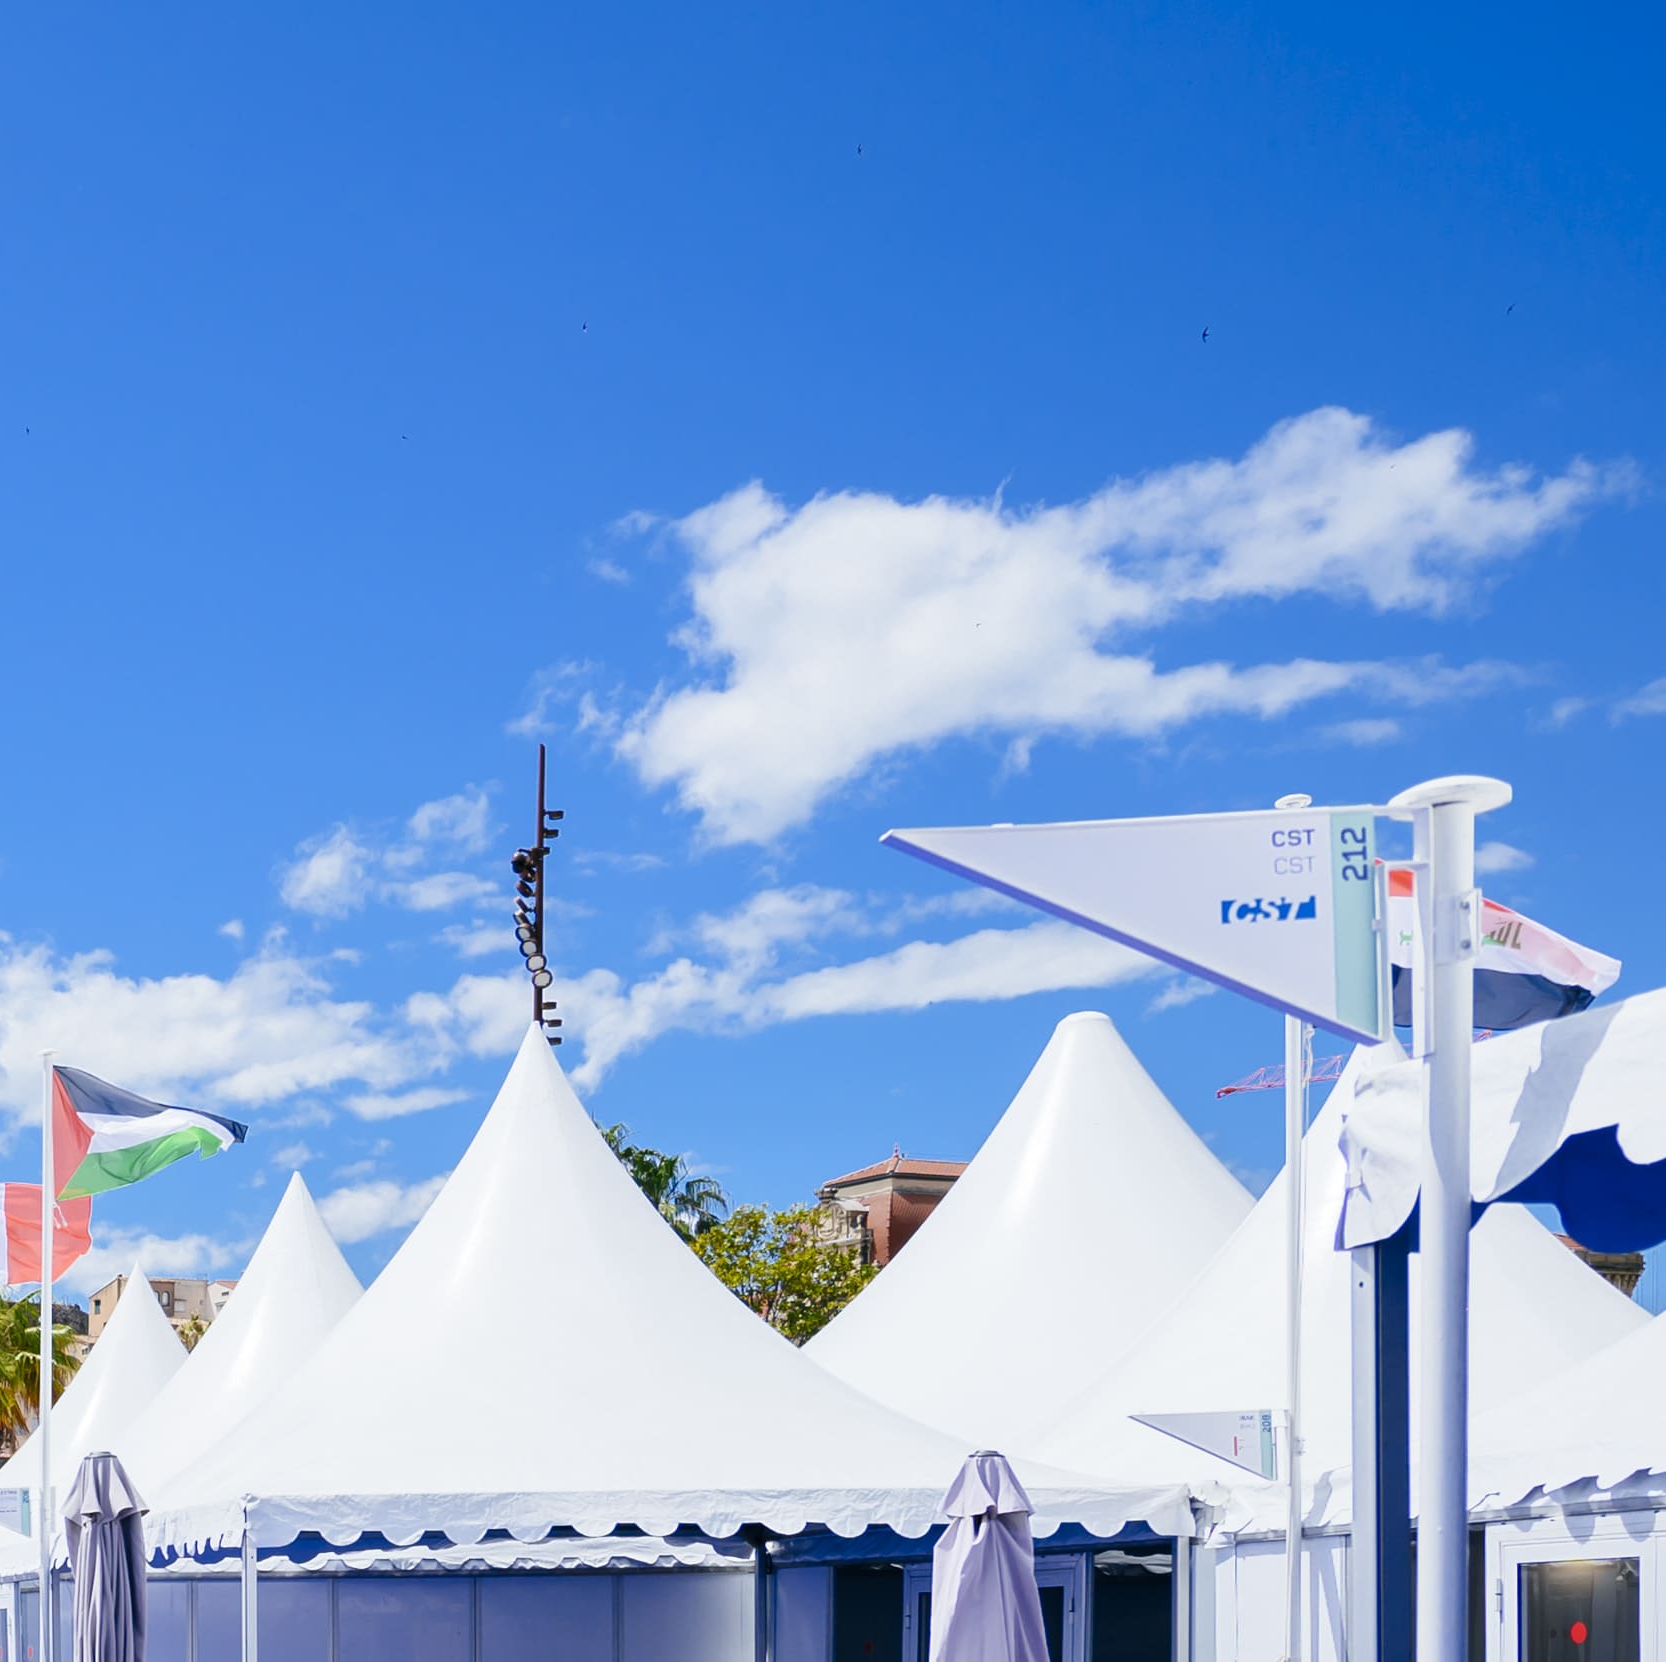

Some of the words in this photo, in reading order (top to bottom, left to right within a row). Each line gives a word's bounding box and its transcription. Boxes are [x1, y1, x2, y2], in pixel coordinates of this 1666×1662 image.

[1271, 828, 1316, 848] CST
[1340, 826, 1369, 882] 212
[1273, 855, 1316, 876] CST
